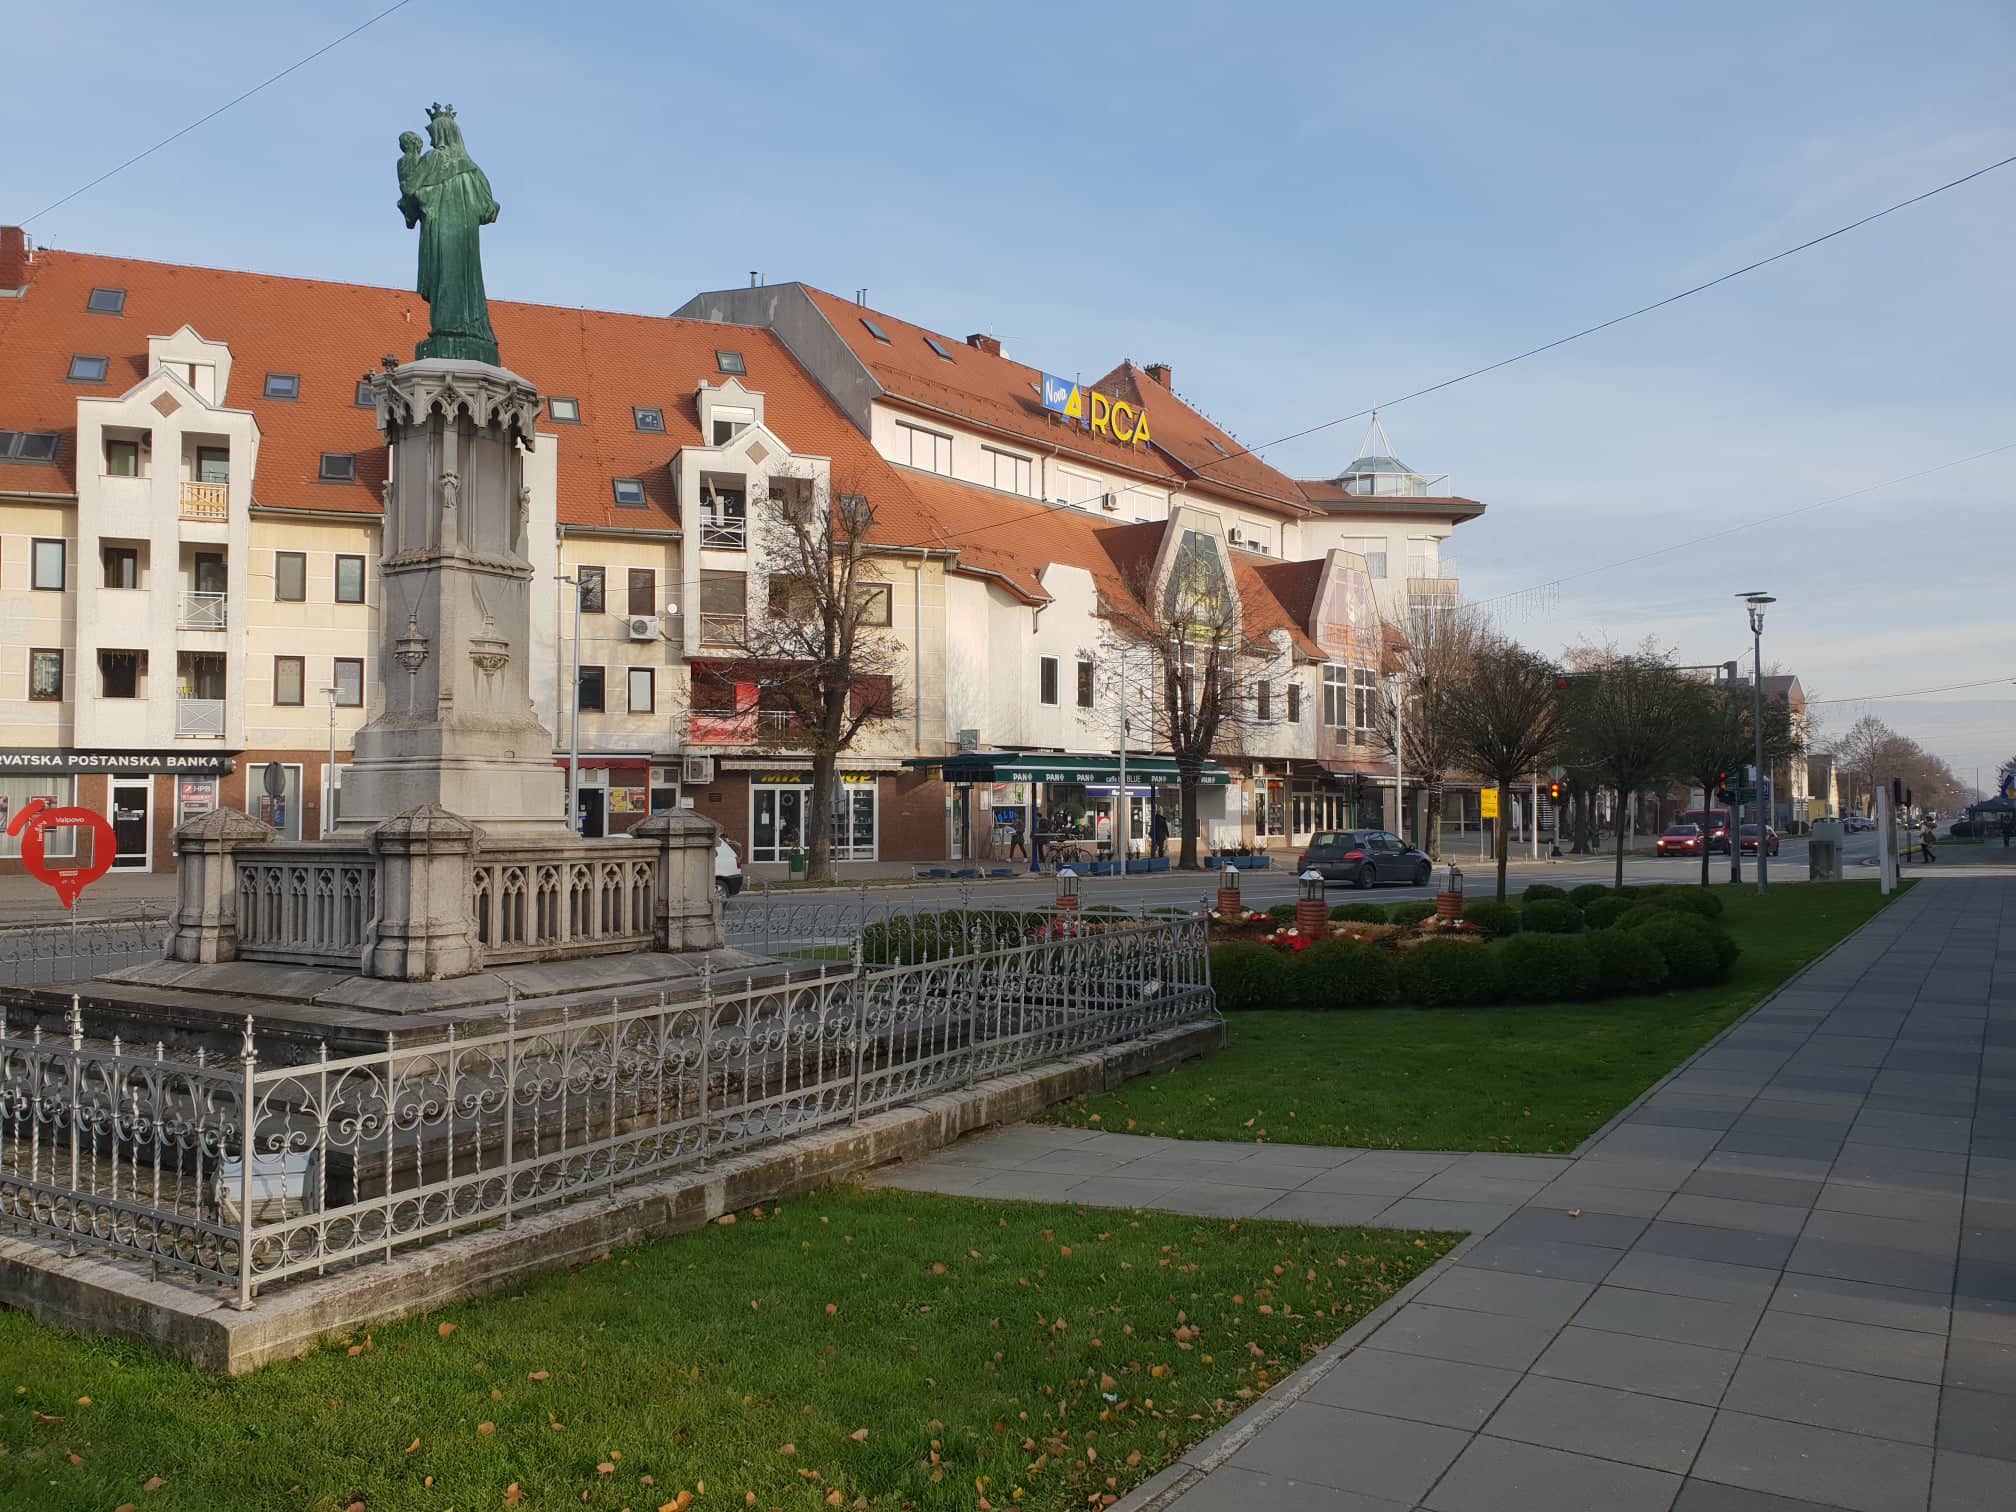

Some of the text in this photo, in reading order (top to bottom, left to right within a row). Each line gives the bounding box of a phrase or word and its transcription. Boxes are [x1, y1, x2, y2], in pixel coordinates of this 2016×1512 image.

[1045, 379, 1151, 449] Nova ARCA
[0, 755, 63, 766] VATSKA
[166, 756, 219, 767] BANKA
[1012, 773, 1028, 782] PAN
[1045, 773, 1060, 782] PAN
[1076, 774, 1091, 782] PAN
[1126, 775, 1142, 783] BLUE
[55, 816, 85, 824] Valpovo
